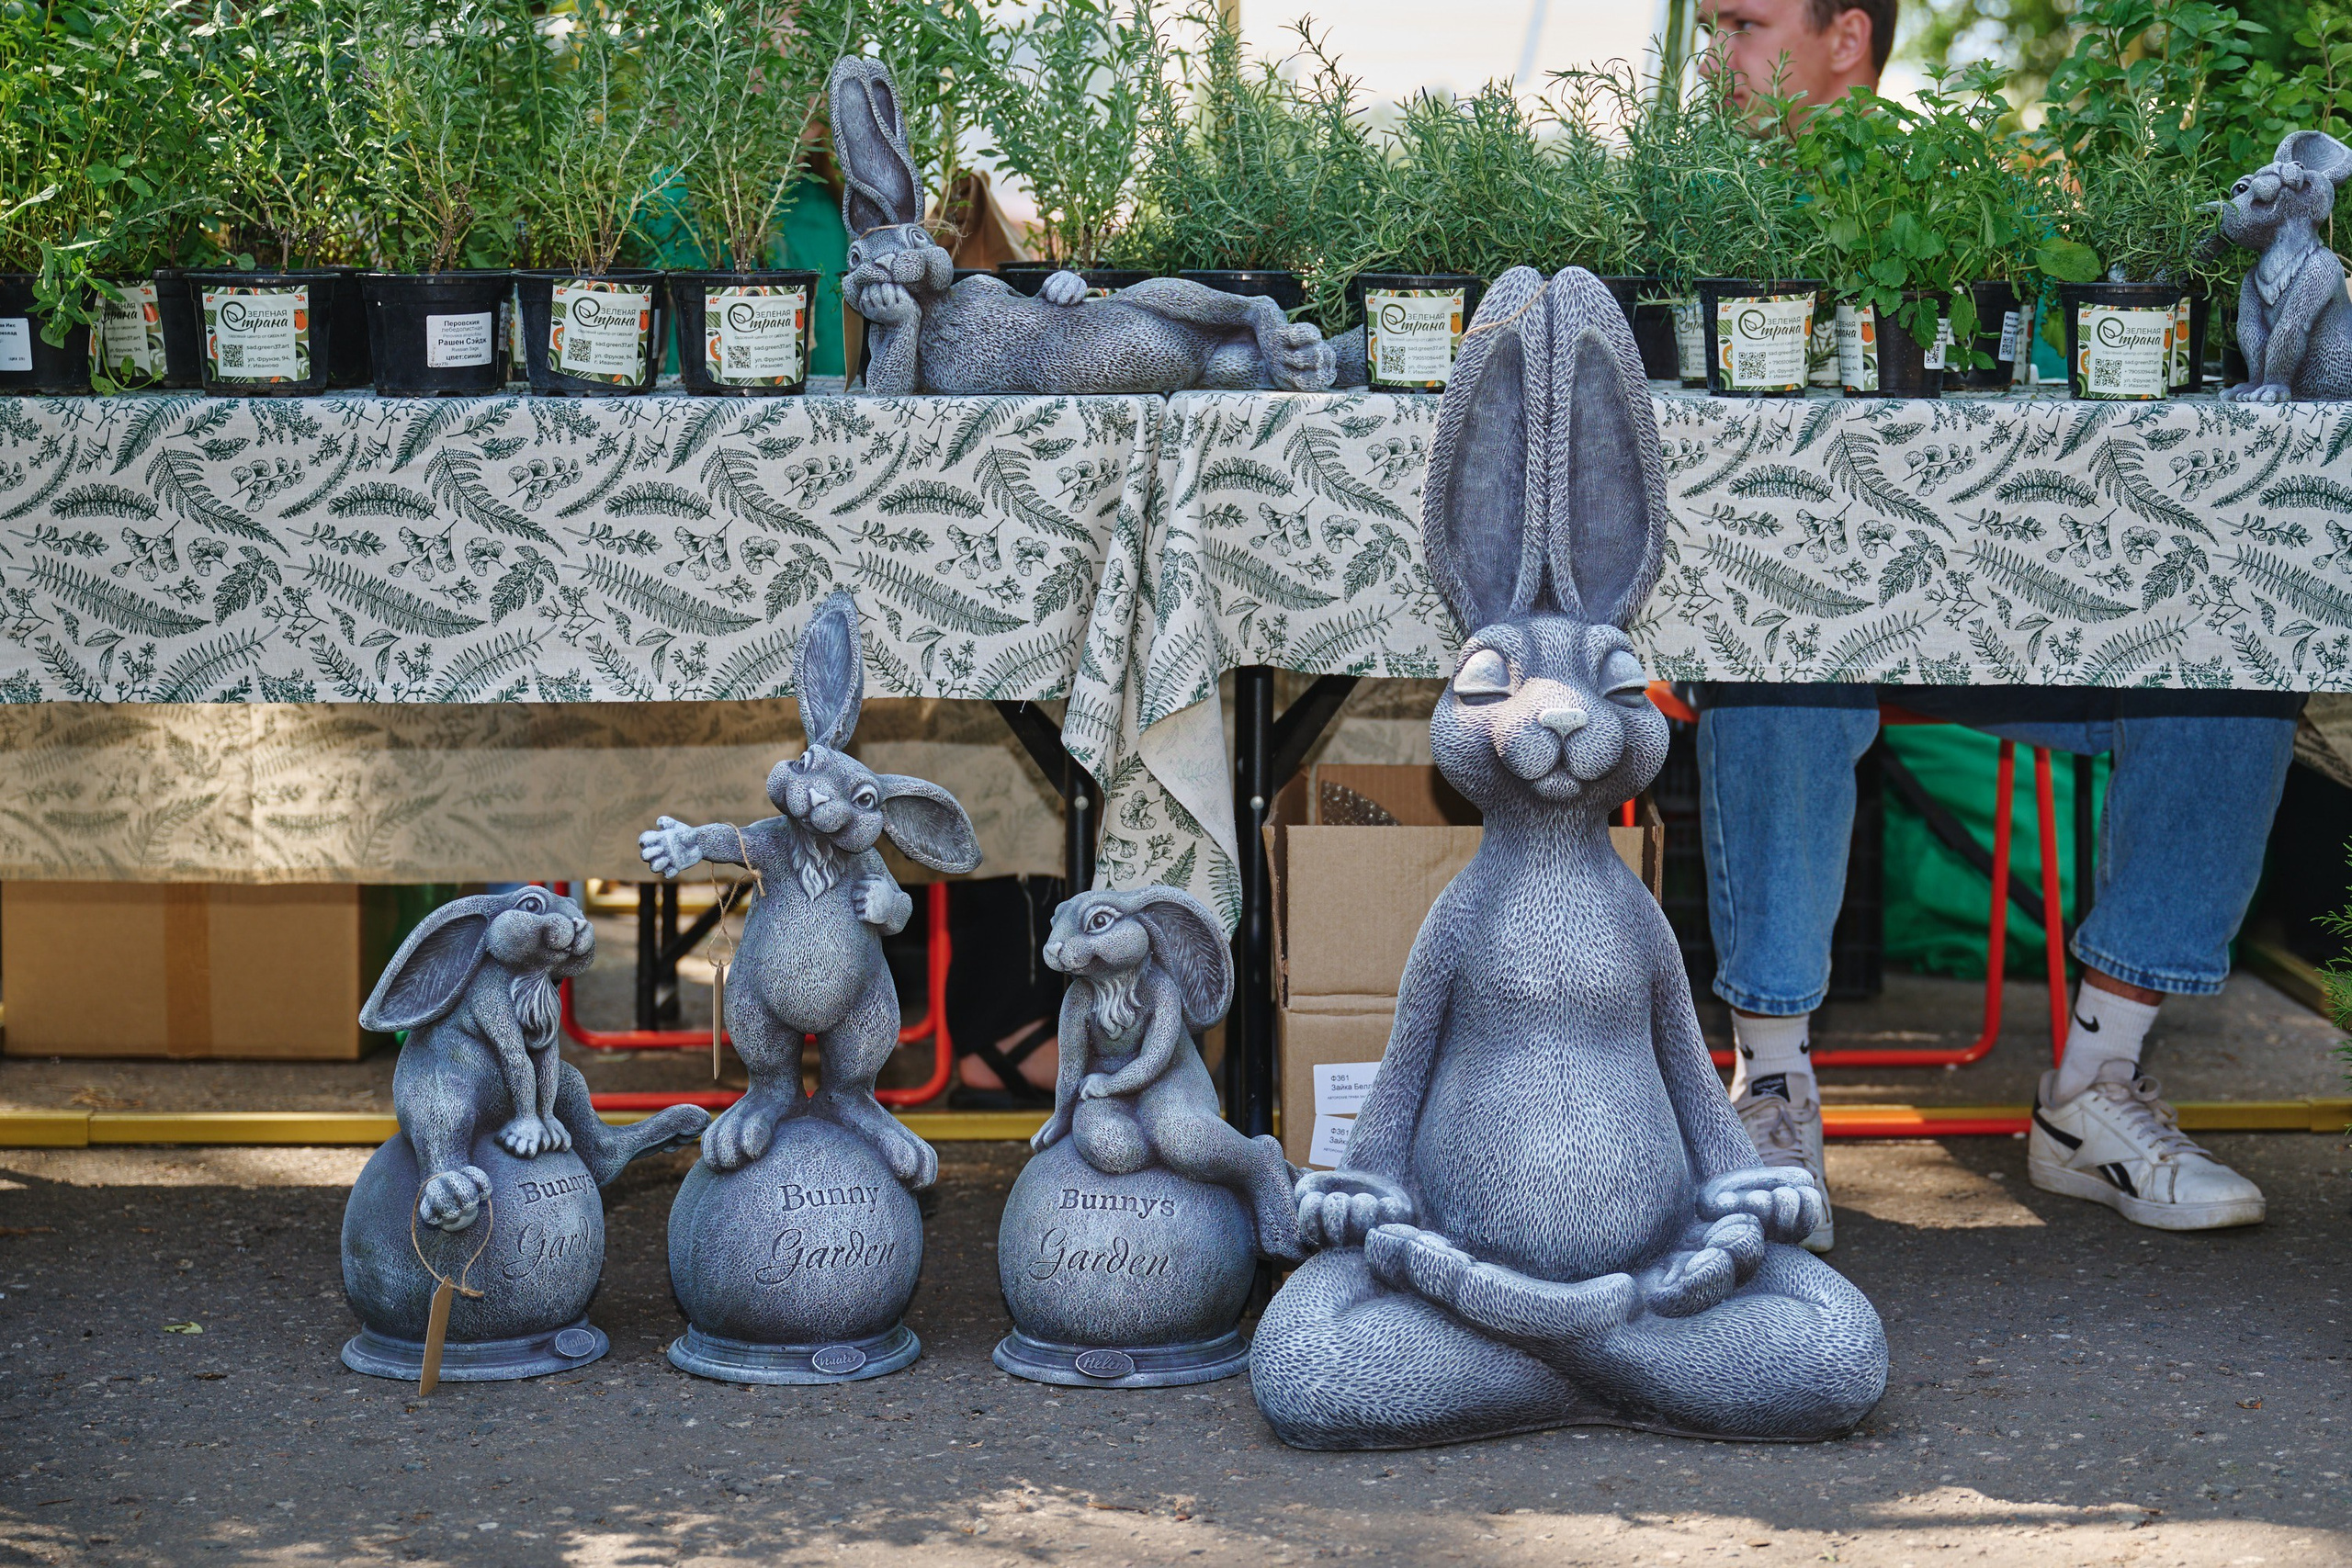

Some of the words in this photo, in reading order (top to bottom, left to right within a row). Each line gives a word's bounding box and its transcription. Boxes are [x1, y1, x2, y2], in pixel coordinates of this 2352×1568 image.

[601, 307, 636, 315] ЗЕЛЕНАЯ
[1767, 316, 1801, 325] ЗЕЛЕНАЯ
[778, 1184, 879, 1212] Bunny
[755, 1229, 894, 1285] Garden
[1029, 1227, 1169, 1280] Garden
[1083, 1354, 1125, 1371] Helen
